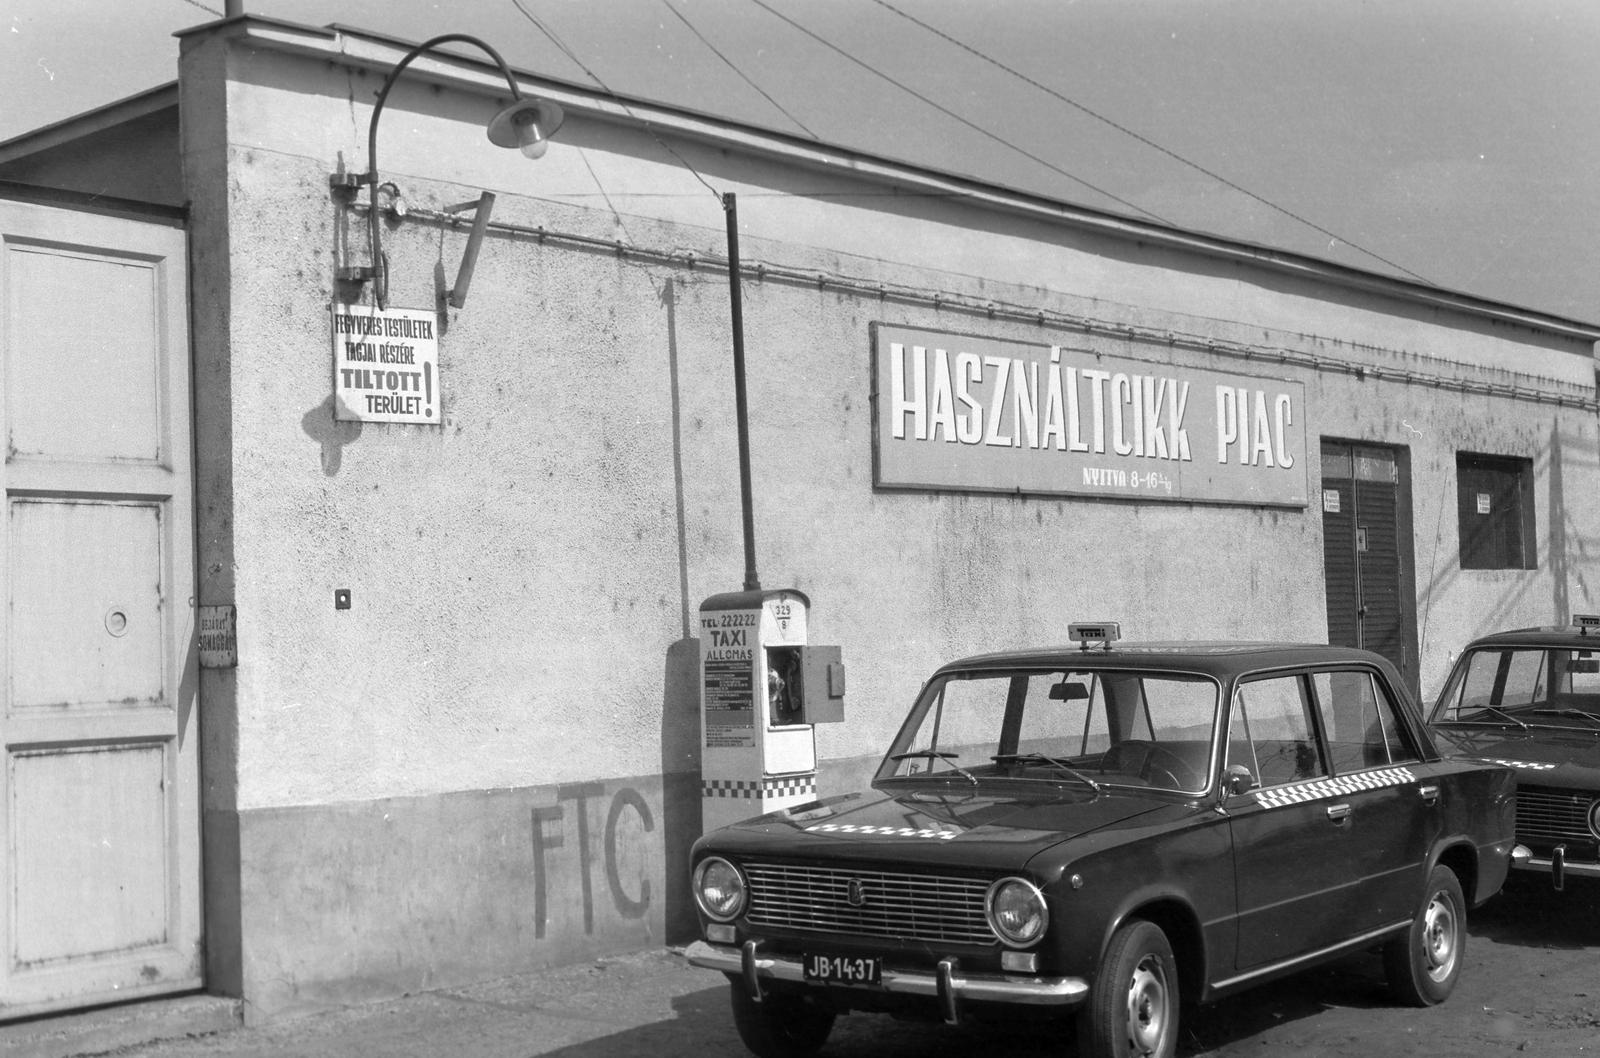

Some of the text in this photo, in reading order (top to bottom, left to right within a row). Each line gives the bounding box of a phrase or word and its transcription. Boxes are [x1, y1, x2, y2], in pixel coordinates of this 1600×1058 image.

[335, 314, 433, 340] FEGYVERES TESTÜLETEK
[345, 341, 415, 364] TAGJAI RÉSZÉRE
[341, 369, 421, 391] TILTOTT
[890, 343, 1295, 469] HASZNÁLTCIKK PIAC
[710, 629, 747, 648] TAXI
[531, 783, 655, 940] FTC
